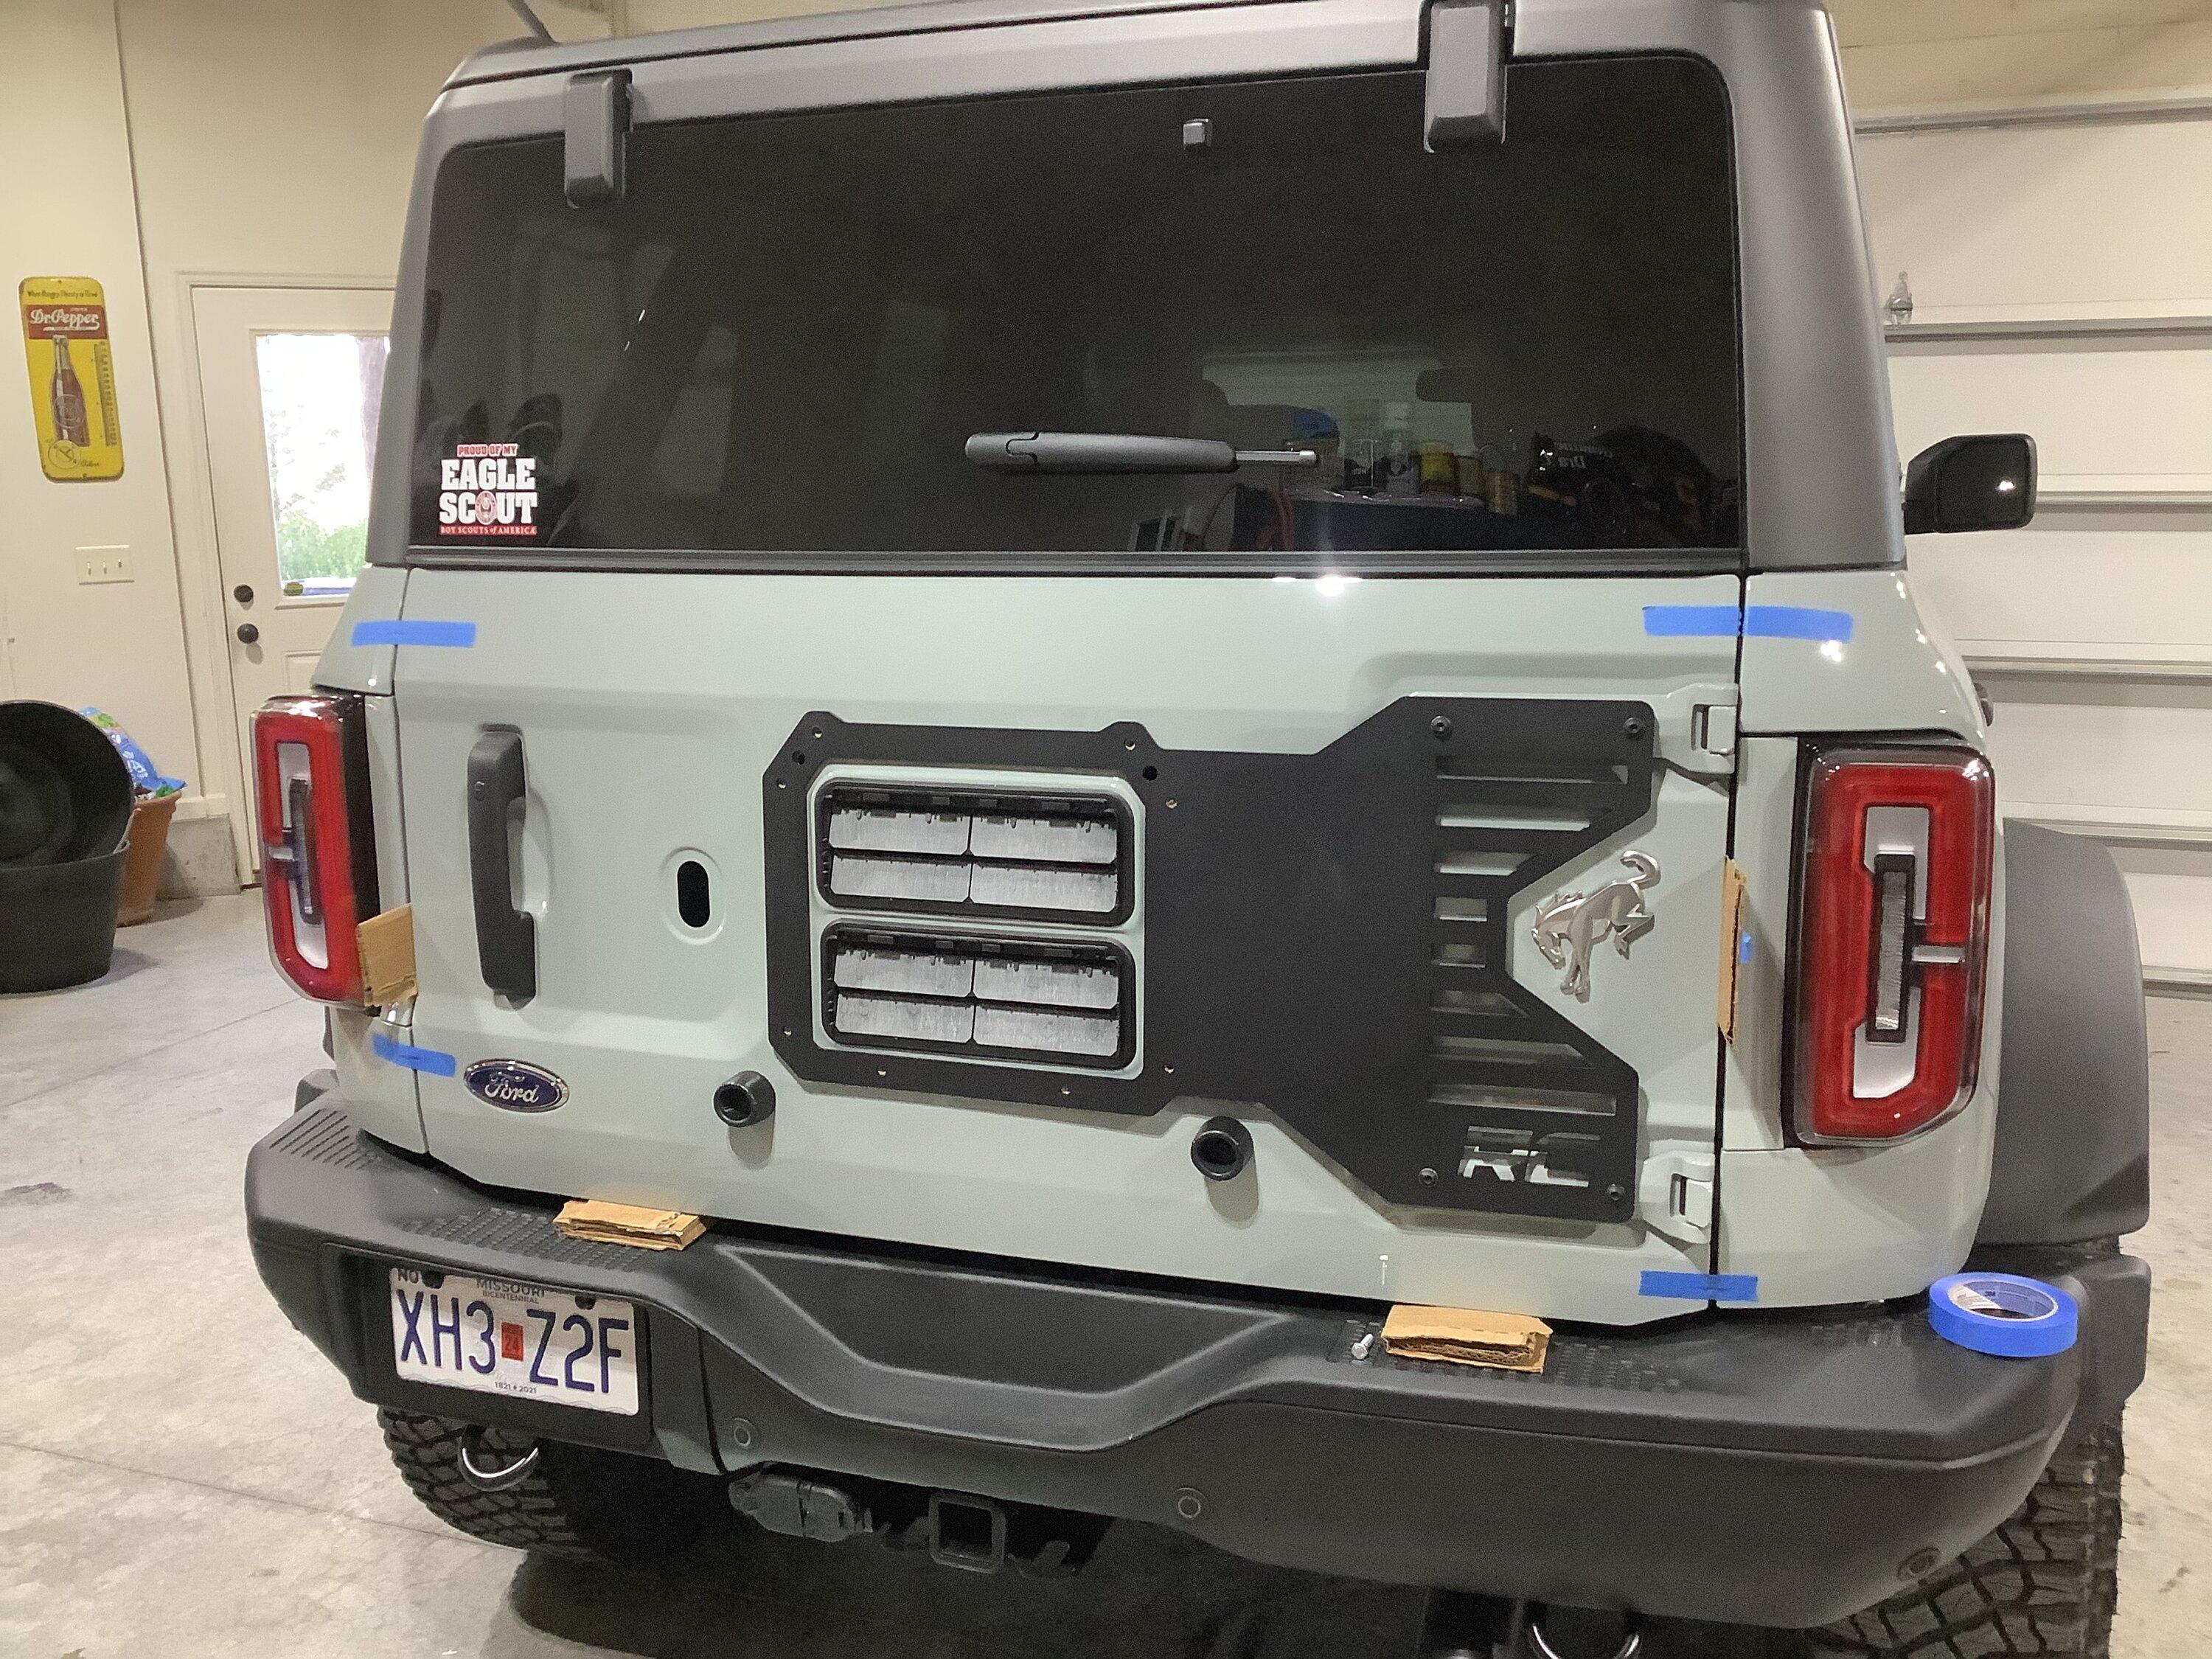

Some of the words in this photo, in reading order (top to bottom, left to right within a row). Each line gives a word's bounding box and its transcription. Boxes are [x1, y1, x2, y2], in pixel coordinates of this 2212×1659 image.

[458, 445, 487, 456] PROUD
[490, 445, 501, 456] OF
[503, 445, 517, 456] MY
[441, 458, 535, 490] EAGLE
[439, 490, 538, 525] SCOUT
[441, 526, 456, 535] BOY
[458, 526, 489, 535] SCOUTS
[490, 526, 497, 535] of
[498, 526, 536, 535] AMERICA
[484, 1074, 539, 1103] Ford
[476, 1279, 545, 1298] MISSOURI
[482, 1290, 540, 1304] BICENTENNIAL
[397, 1289, 495, 1374] XH3
[526, 1307, 630, 1394] Z2F
[494, 1381, 512, 1391] 1821
[518, 1385, 538, 1394] 2021
